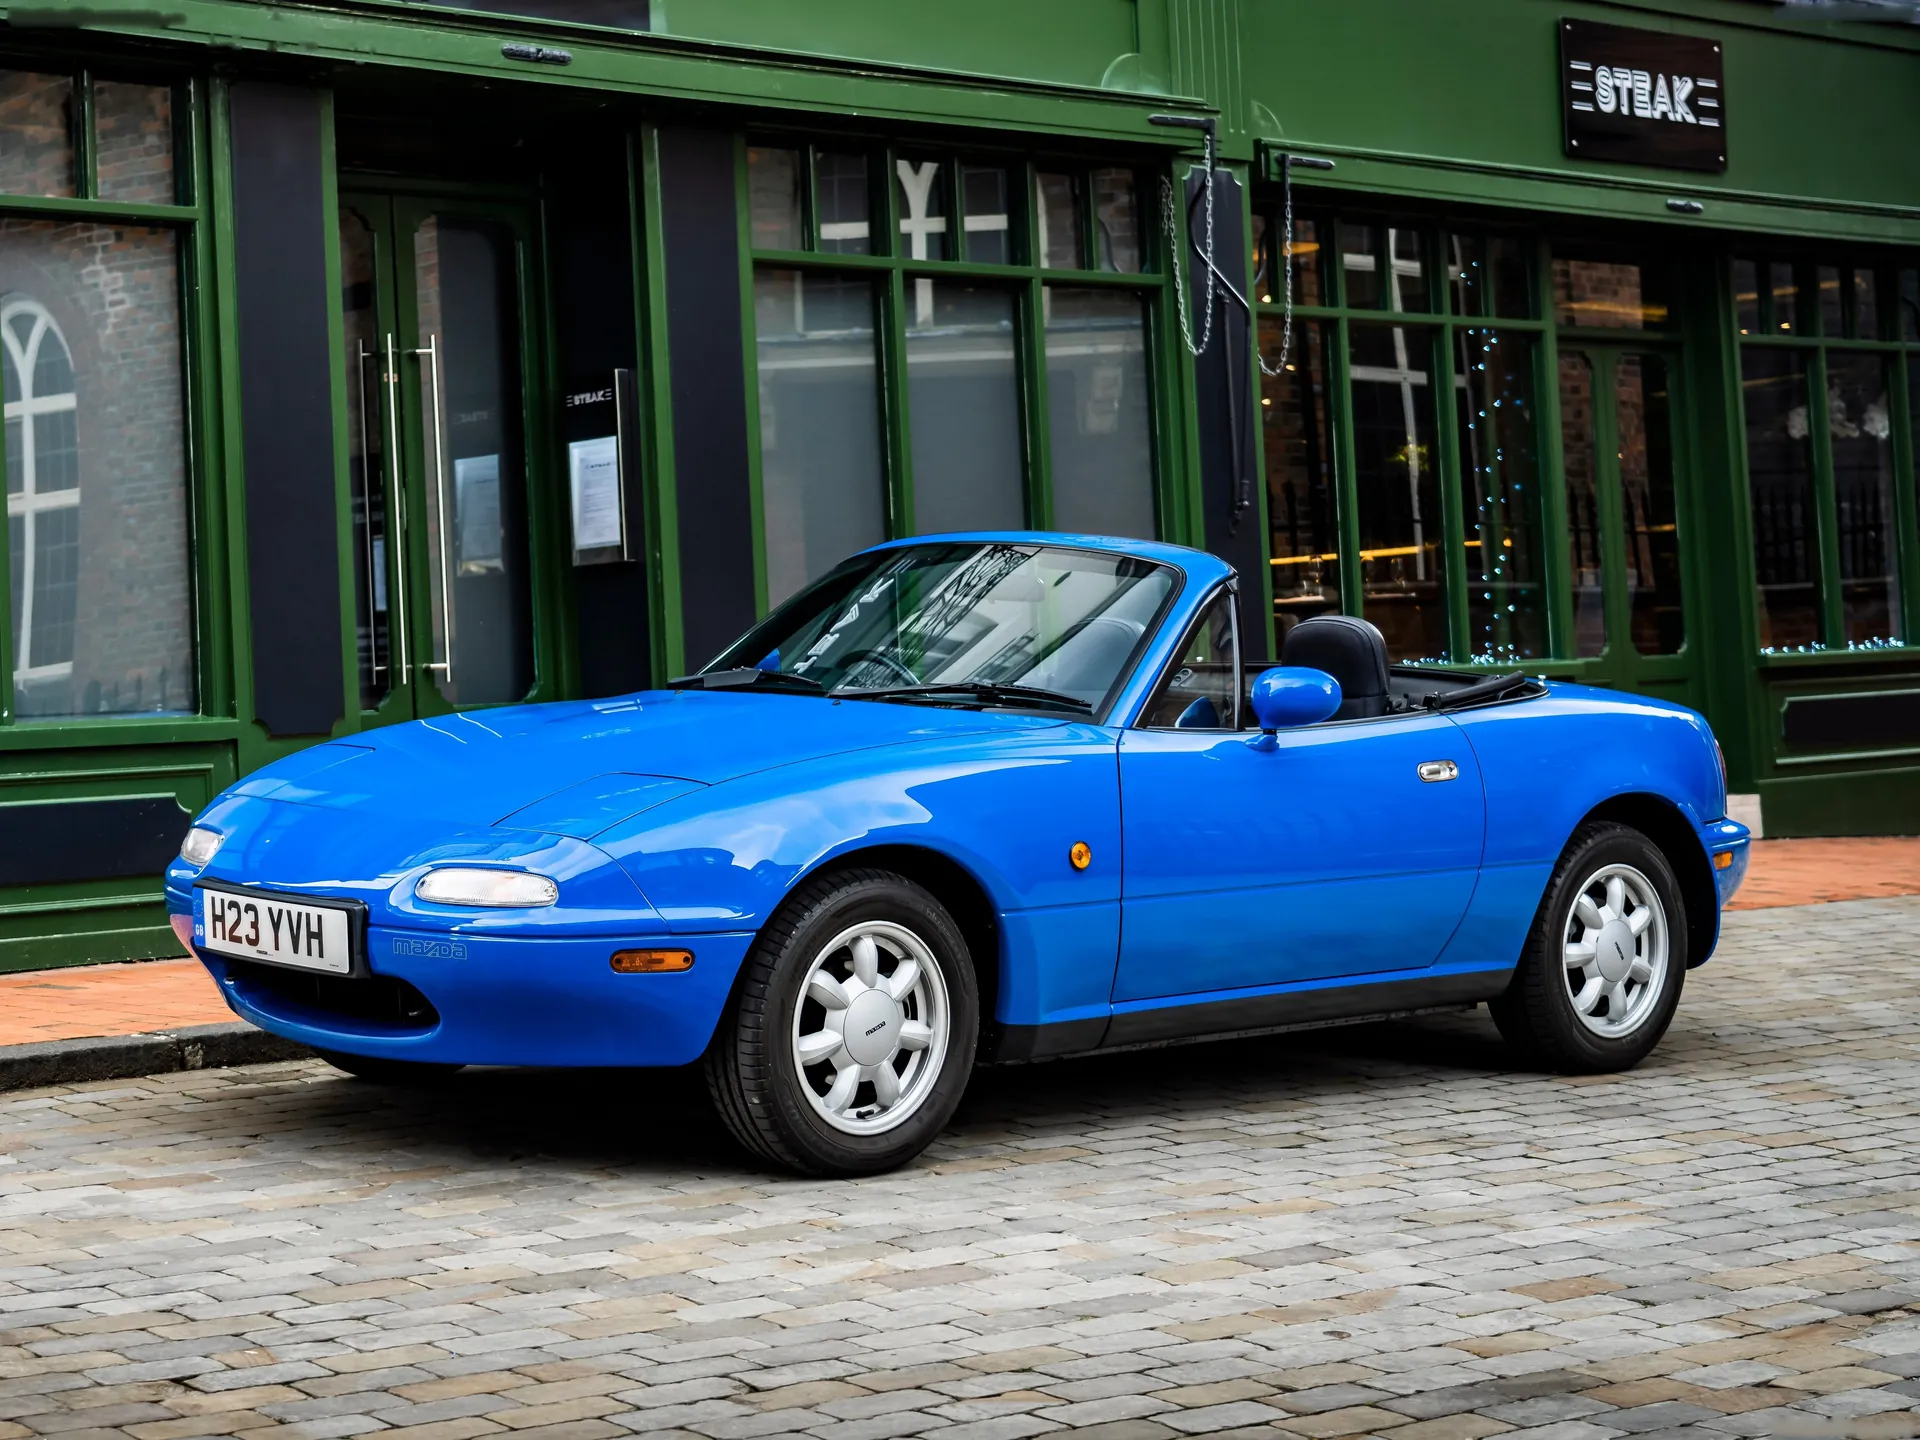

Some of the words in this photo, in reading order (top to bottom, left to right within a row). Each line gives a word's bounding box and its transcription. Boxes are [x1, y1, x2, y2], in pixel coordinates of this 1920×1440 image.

[1595, 65, 1697, 124] STEAK
[574, 390, 604, 405] STEAK
[195, 923, 204, 936] GB
[211, 896, 260, 947] H23
[267, 906, 324, 959] YVH
